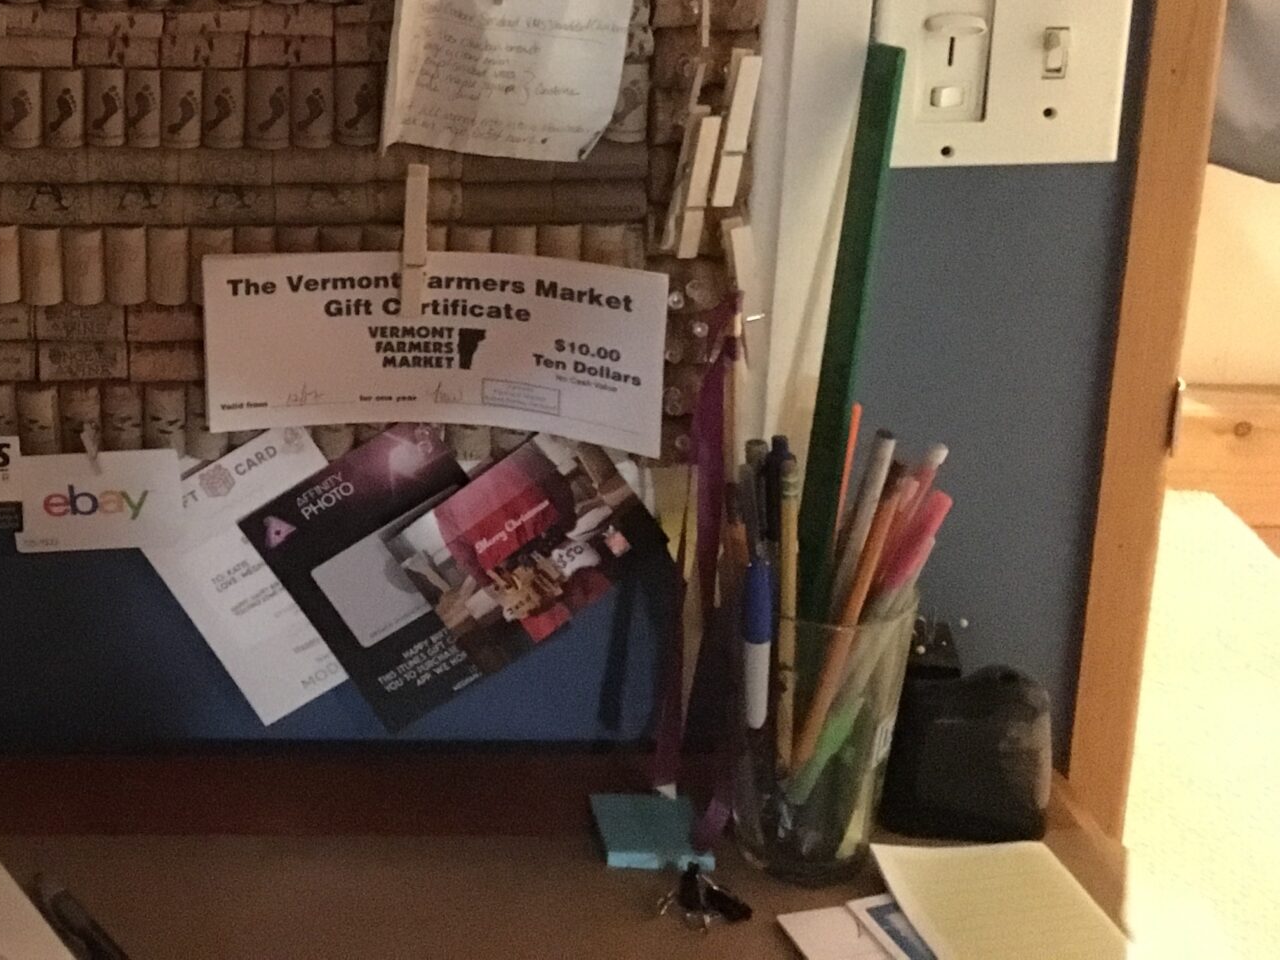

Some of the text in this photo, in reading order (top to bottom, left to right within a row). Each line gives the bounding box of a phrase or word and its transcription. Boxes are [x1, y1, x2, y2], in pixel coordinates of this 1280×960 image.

[227, 271, 634, 314] The Vermont armers Market
[324, 296, 532, 323] Gift Crtificate
[368, 326, 455, 340] VERMONT
[375, 341, 455, 355] FARMERS
[382, 355, 456, 370] MARKET
[554, 338, 622, 363] $10.00
[532, 352, 643, 387] Ten Dollars
[375, 394, 394, 402] one
[396, 394, 418, 404] year
[233, 444, 279, 477] CARD
[42, 484, 150, 521] ebay
[295, 471, 344, 508] AFFINITY
[300, 481, 355, 521] PHOTO
